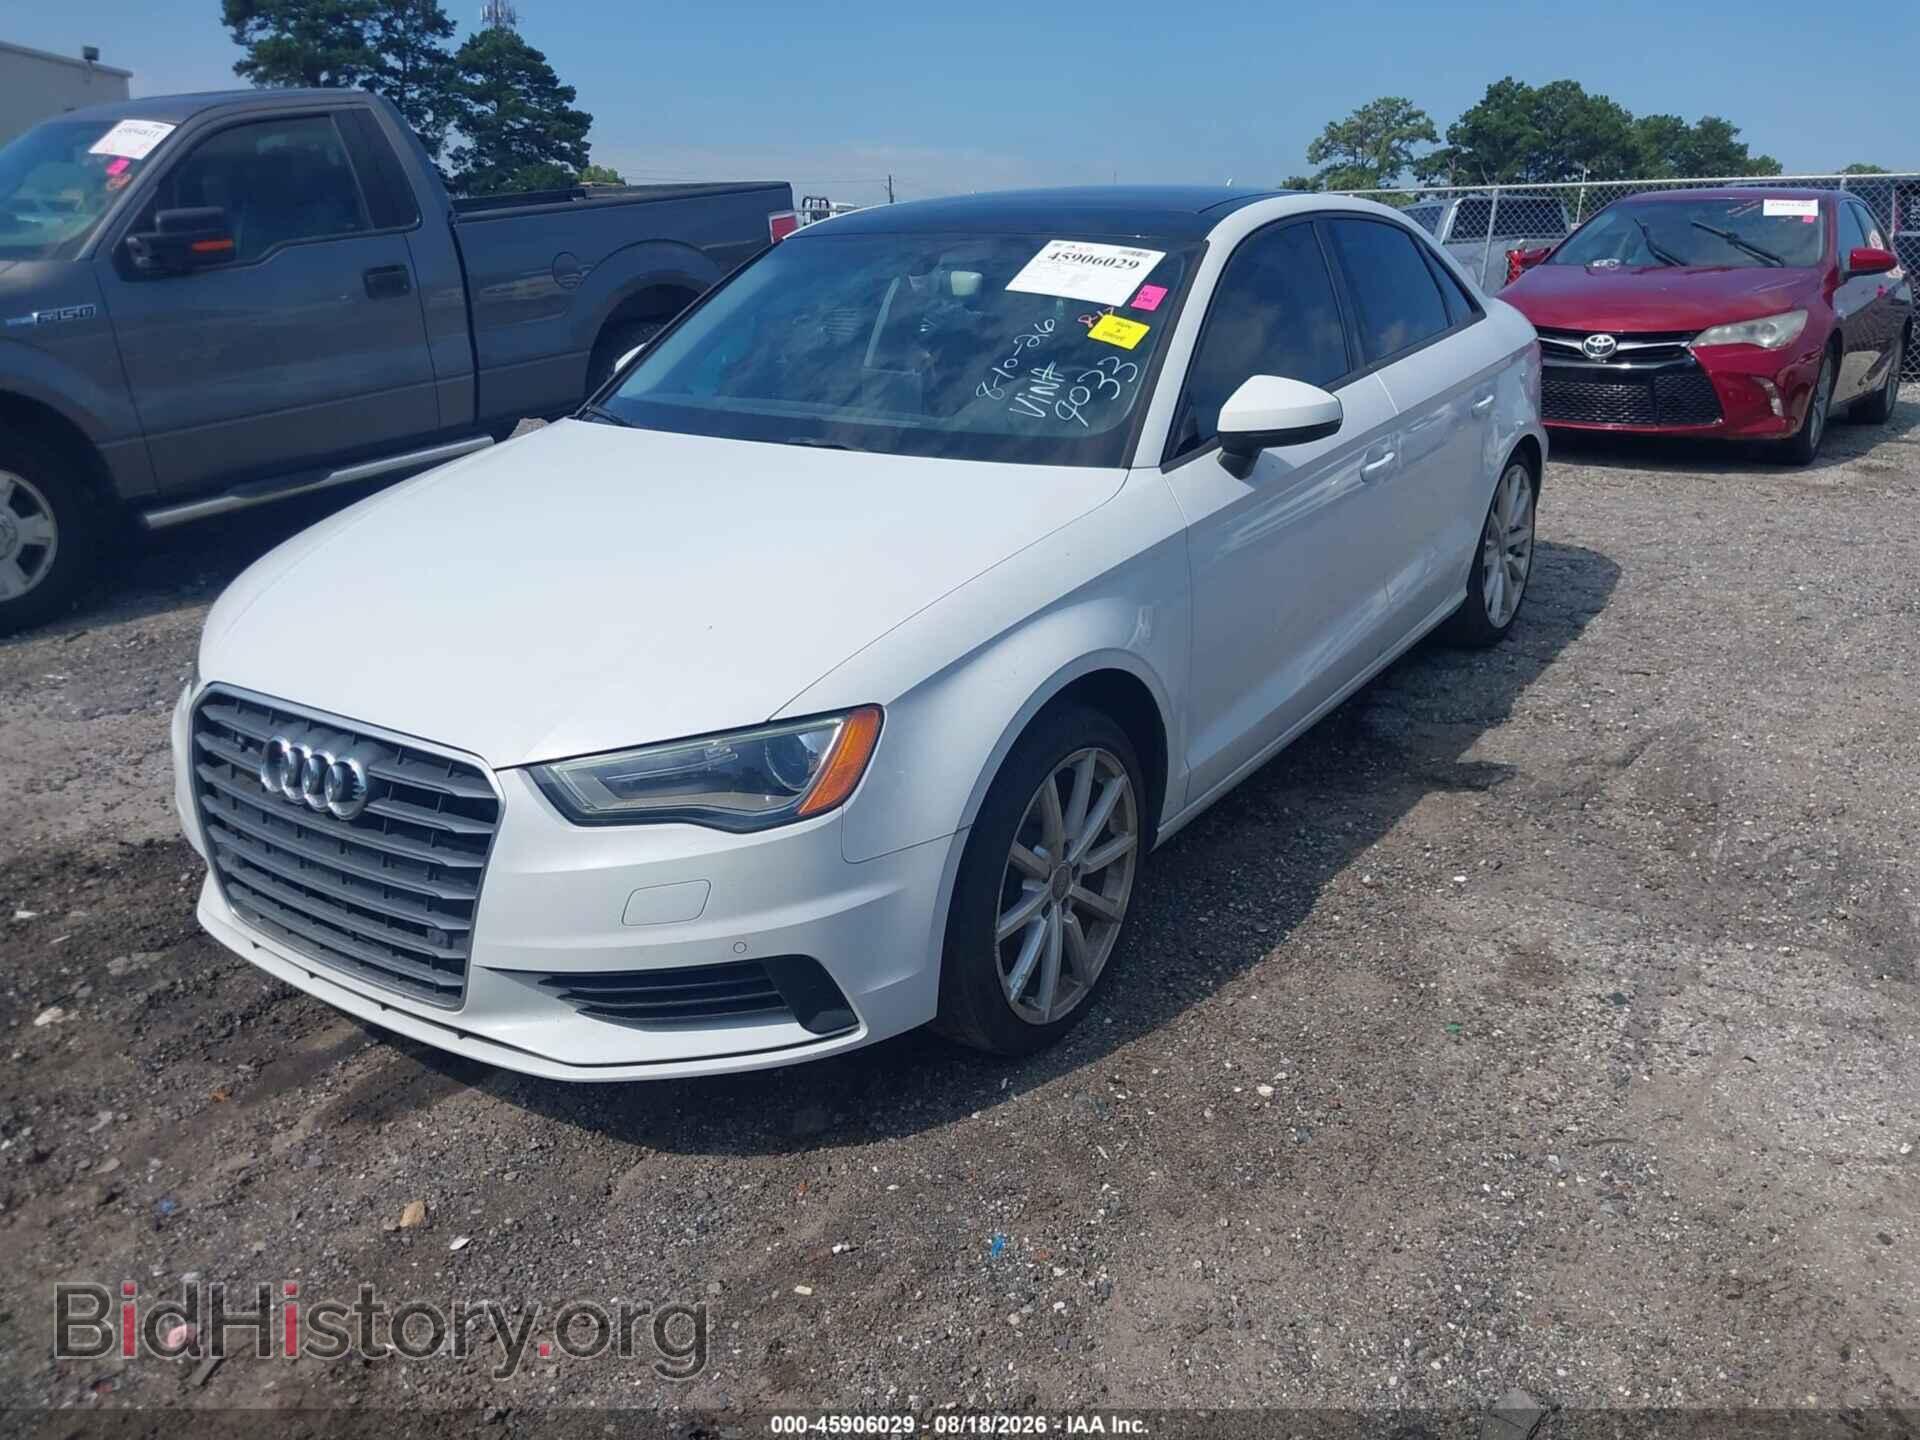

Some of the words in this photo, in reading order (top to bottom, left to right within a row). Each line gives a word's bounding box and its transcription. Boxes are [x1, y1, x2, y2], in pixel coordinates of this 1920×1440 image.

[1047, 251, 1140, 270] 45906029
[976, 318, 1055, 400] 8-10-26
[1055, 356, 1138, 427] 9033
